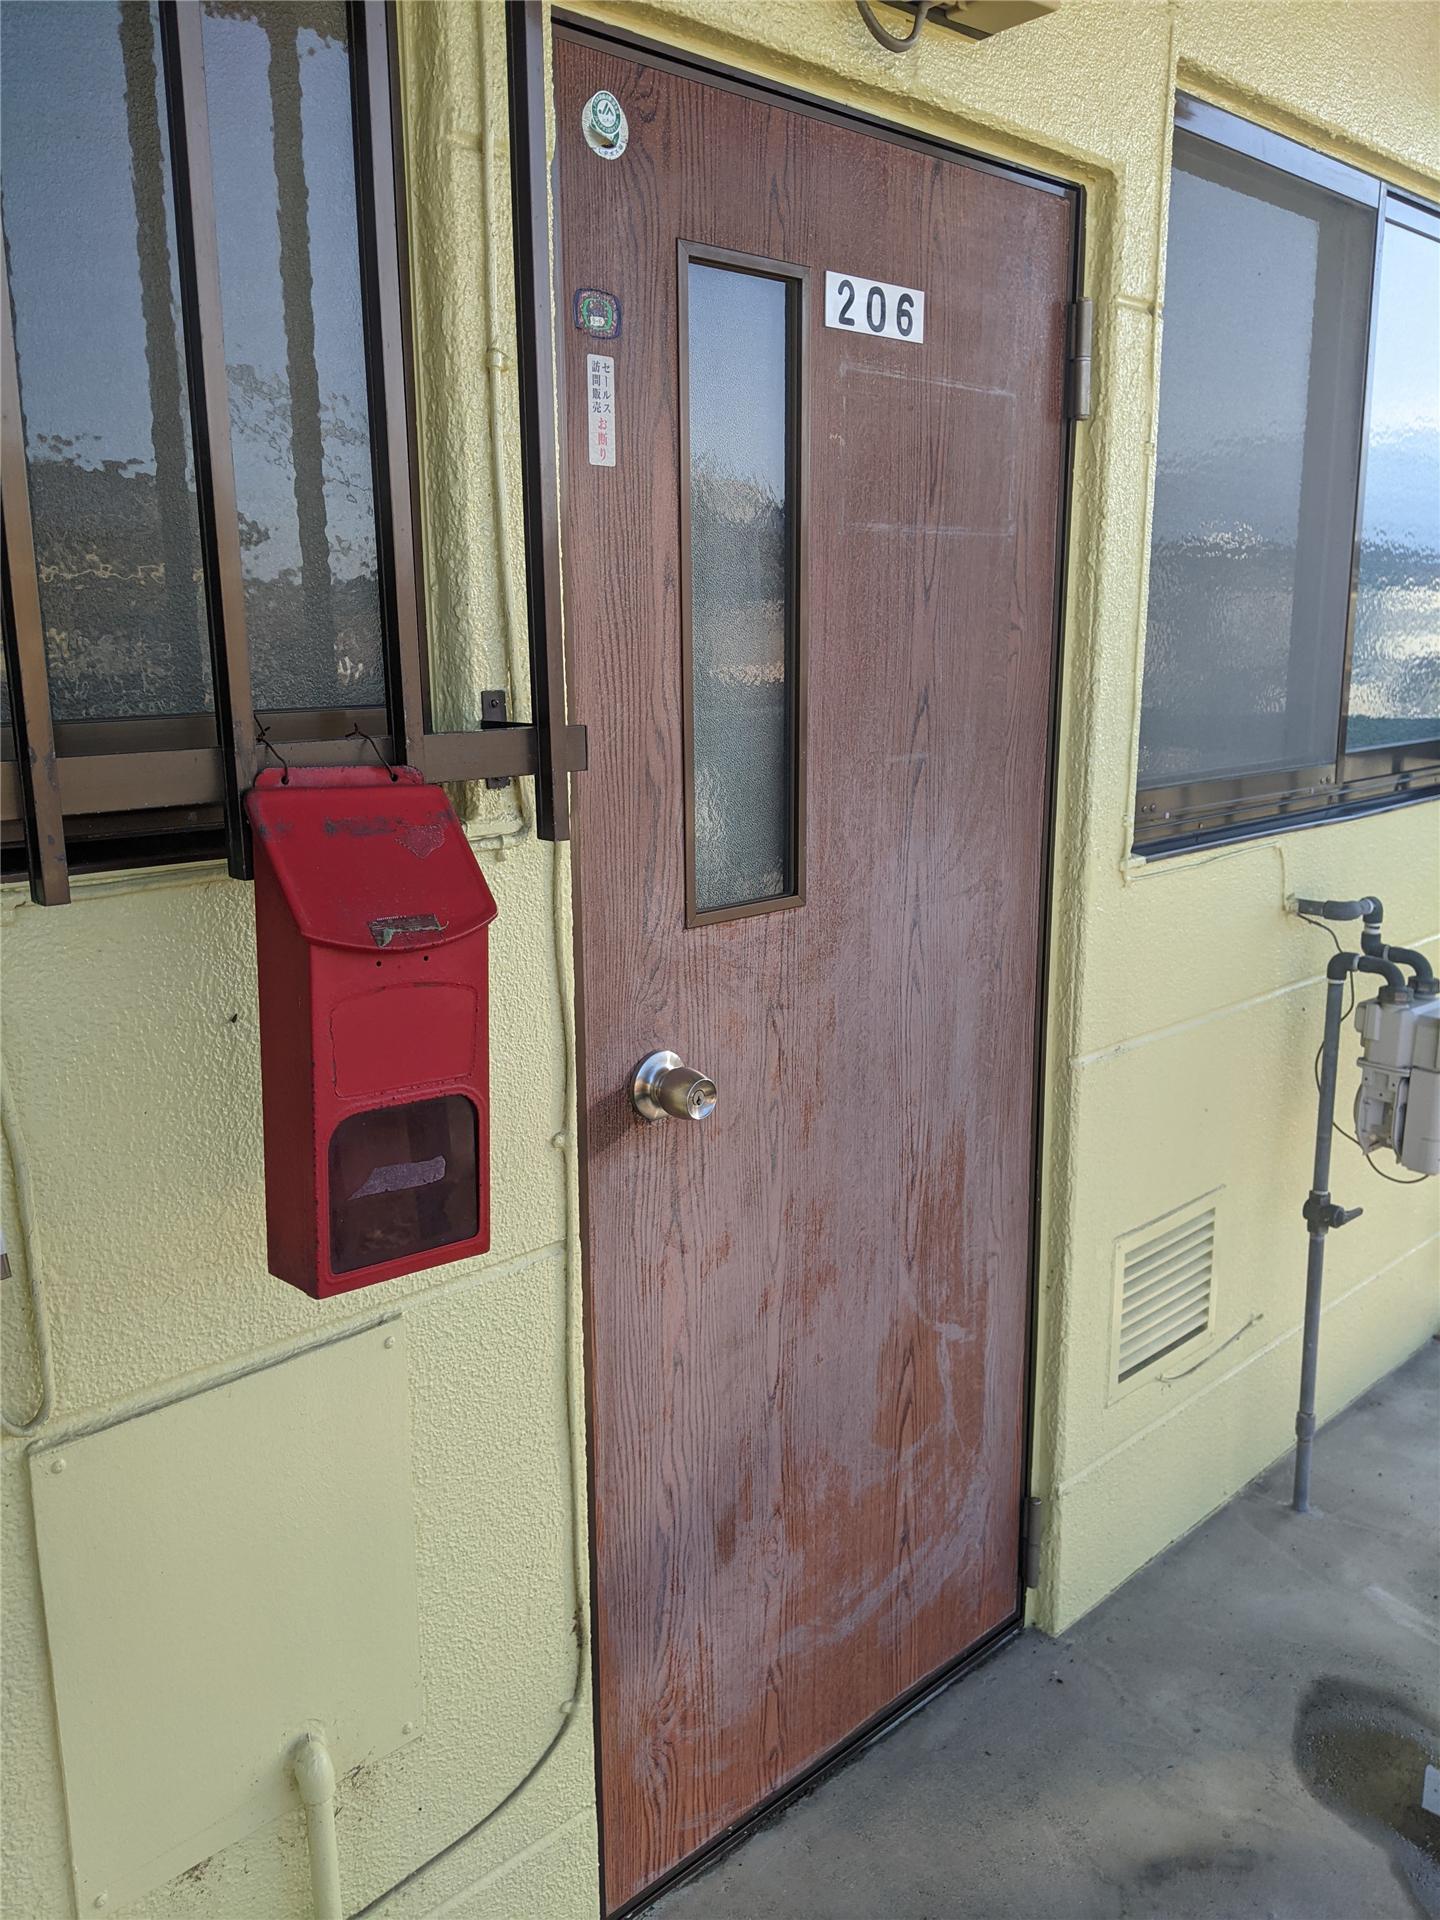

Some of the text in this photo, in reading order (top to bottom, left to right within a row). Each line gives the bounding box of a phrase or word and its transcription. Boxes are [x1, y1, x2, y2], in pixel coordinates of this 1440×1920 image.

[837, 279, 914, 336] 206
[592, 360, 602, 413] 訪問販売
[602, 362, 612, 413] セールス
[597, 417, 608, 462] お断り
